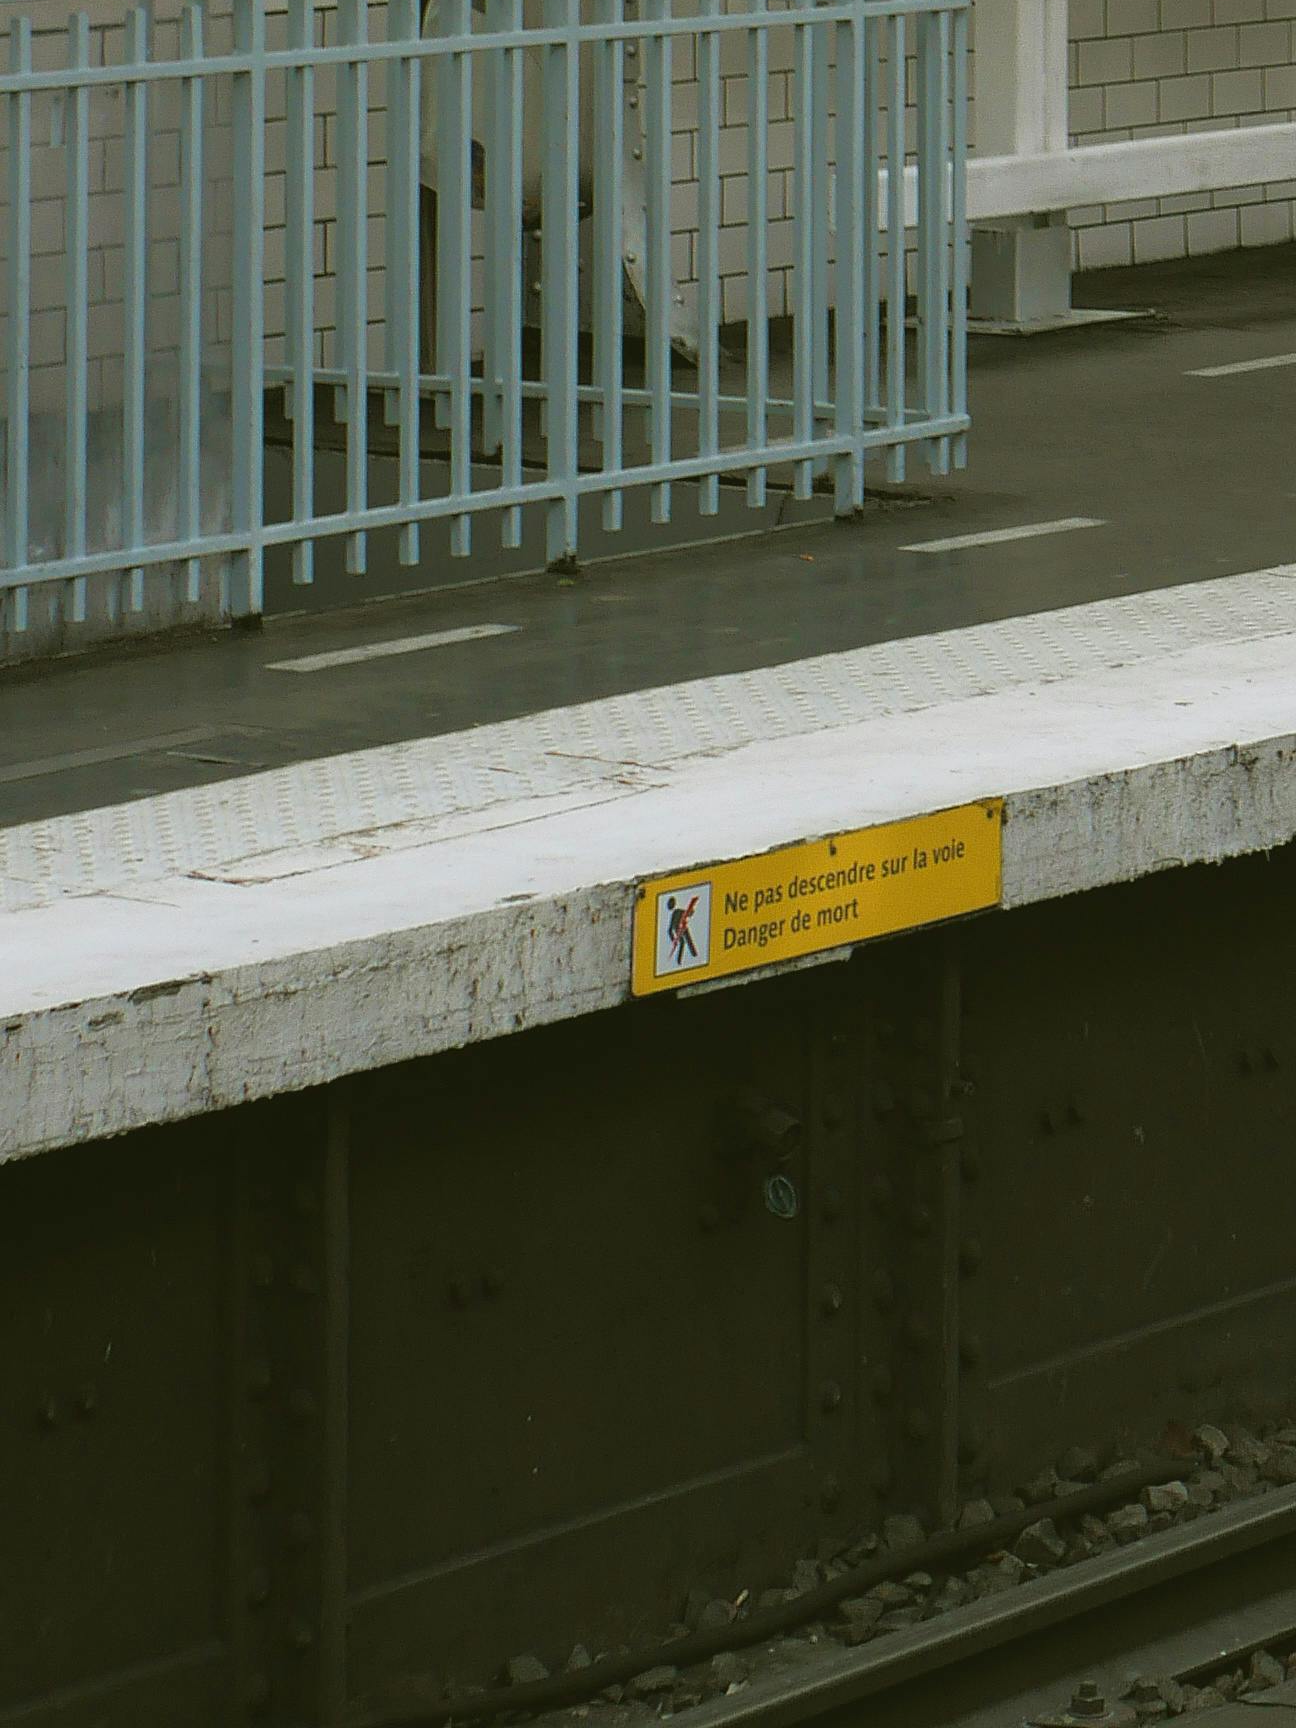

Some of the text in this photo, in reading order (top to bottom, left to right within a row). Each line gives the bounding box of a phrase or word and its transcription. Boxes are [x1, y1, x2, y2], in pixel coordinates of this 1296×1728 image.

[724, 837, 966, 916] Ne pas descendre sur la voie
[723, 897, 860, 951] Danger de mort
